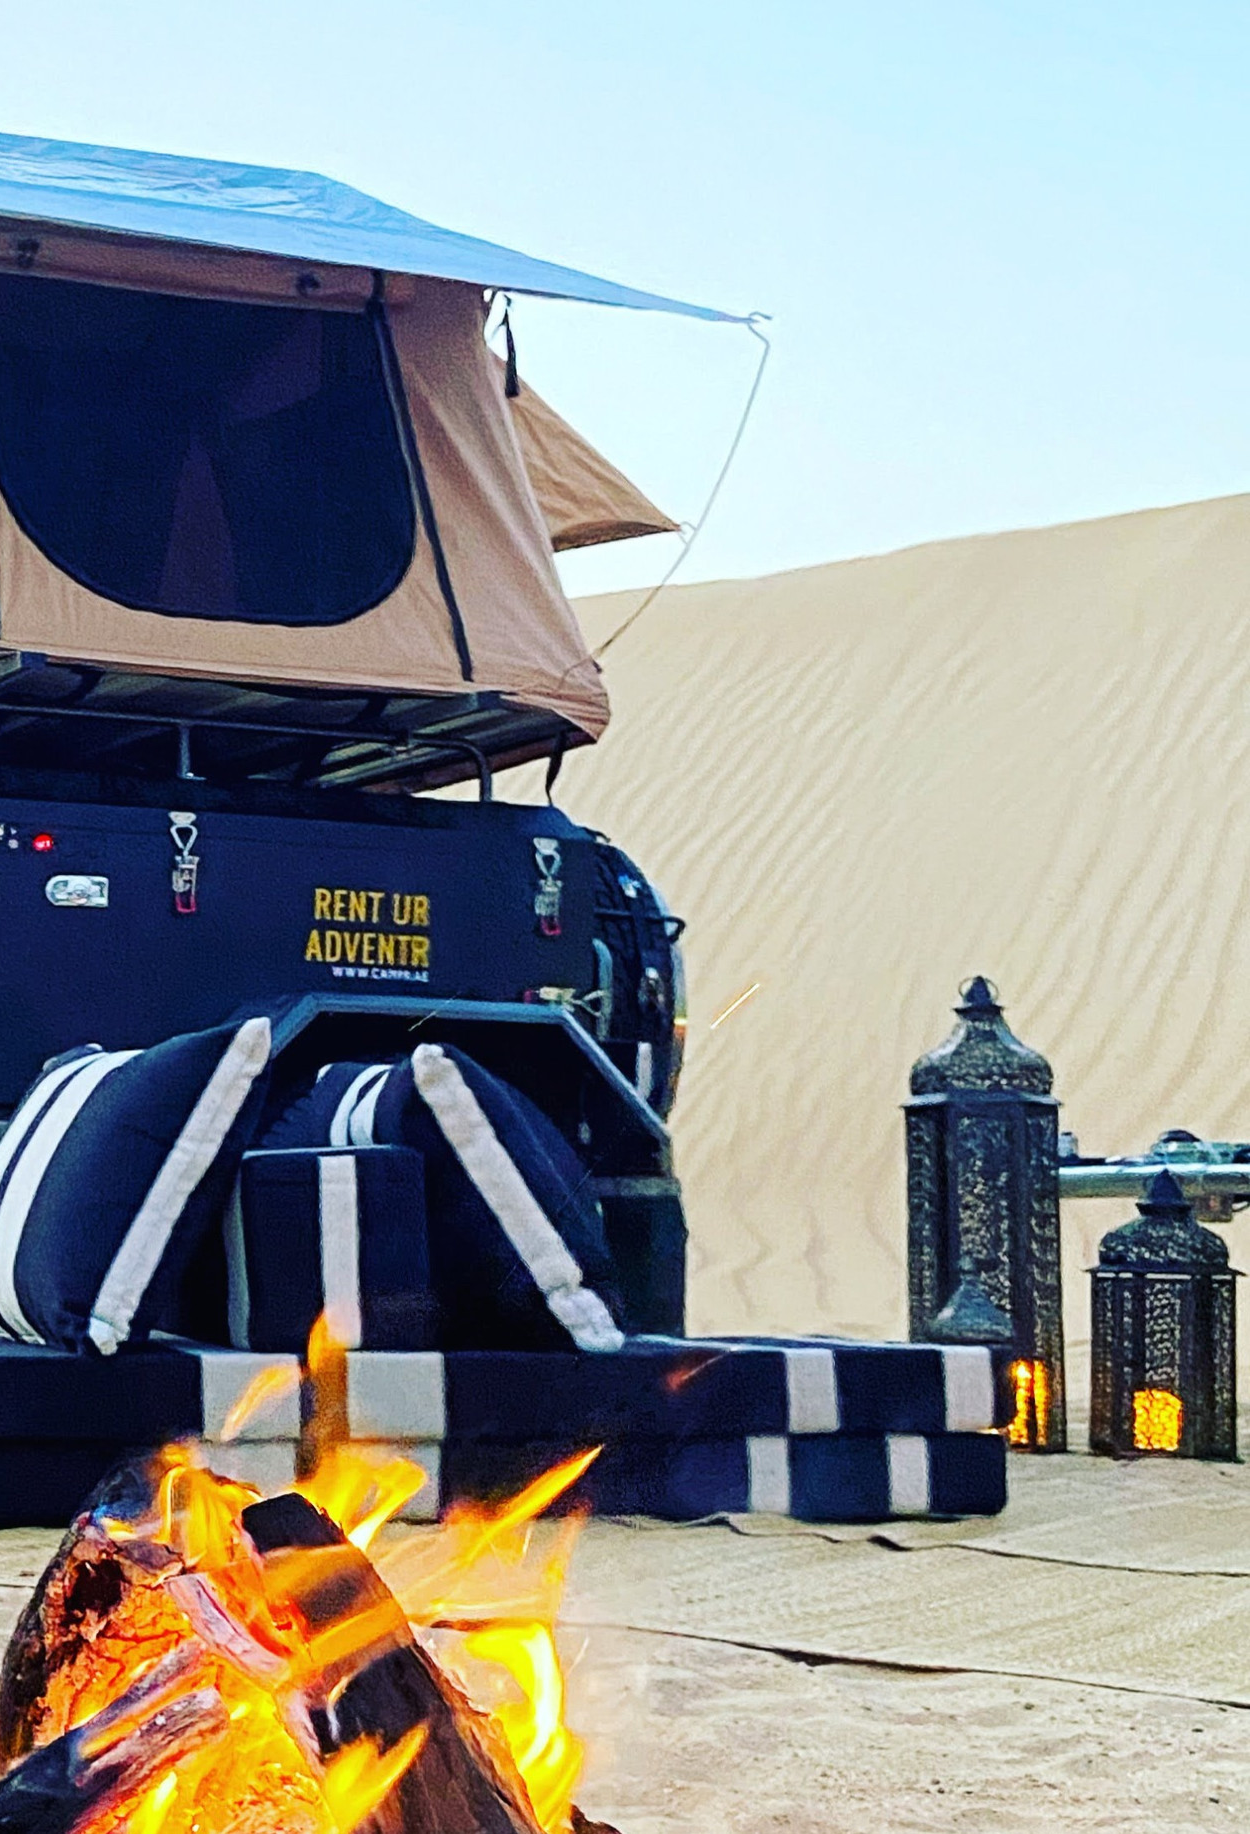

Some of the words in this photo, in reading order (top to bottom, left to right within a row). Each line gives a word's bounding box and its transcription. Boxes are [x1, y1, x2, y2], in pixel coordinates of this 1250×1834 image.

[314, 887, 385, 923] RENT
[393, 893, 430, 926] UR
[305, 929, 430, 967] ADVENTR
